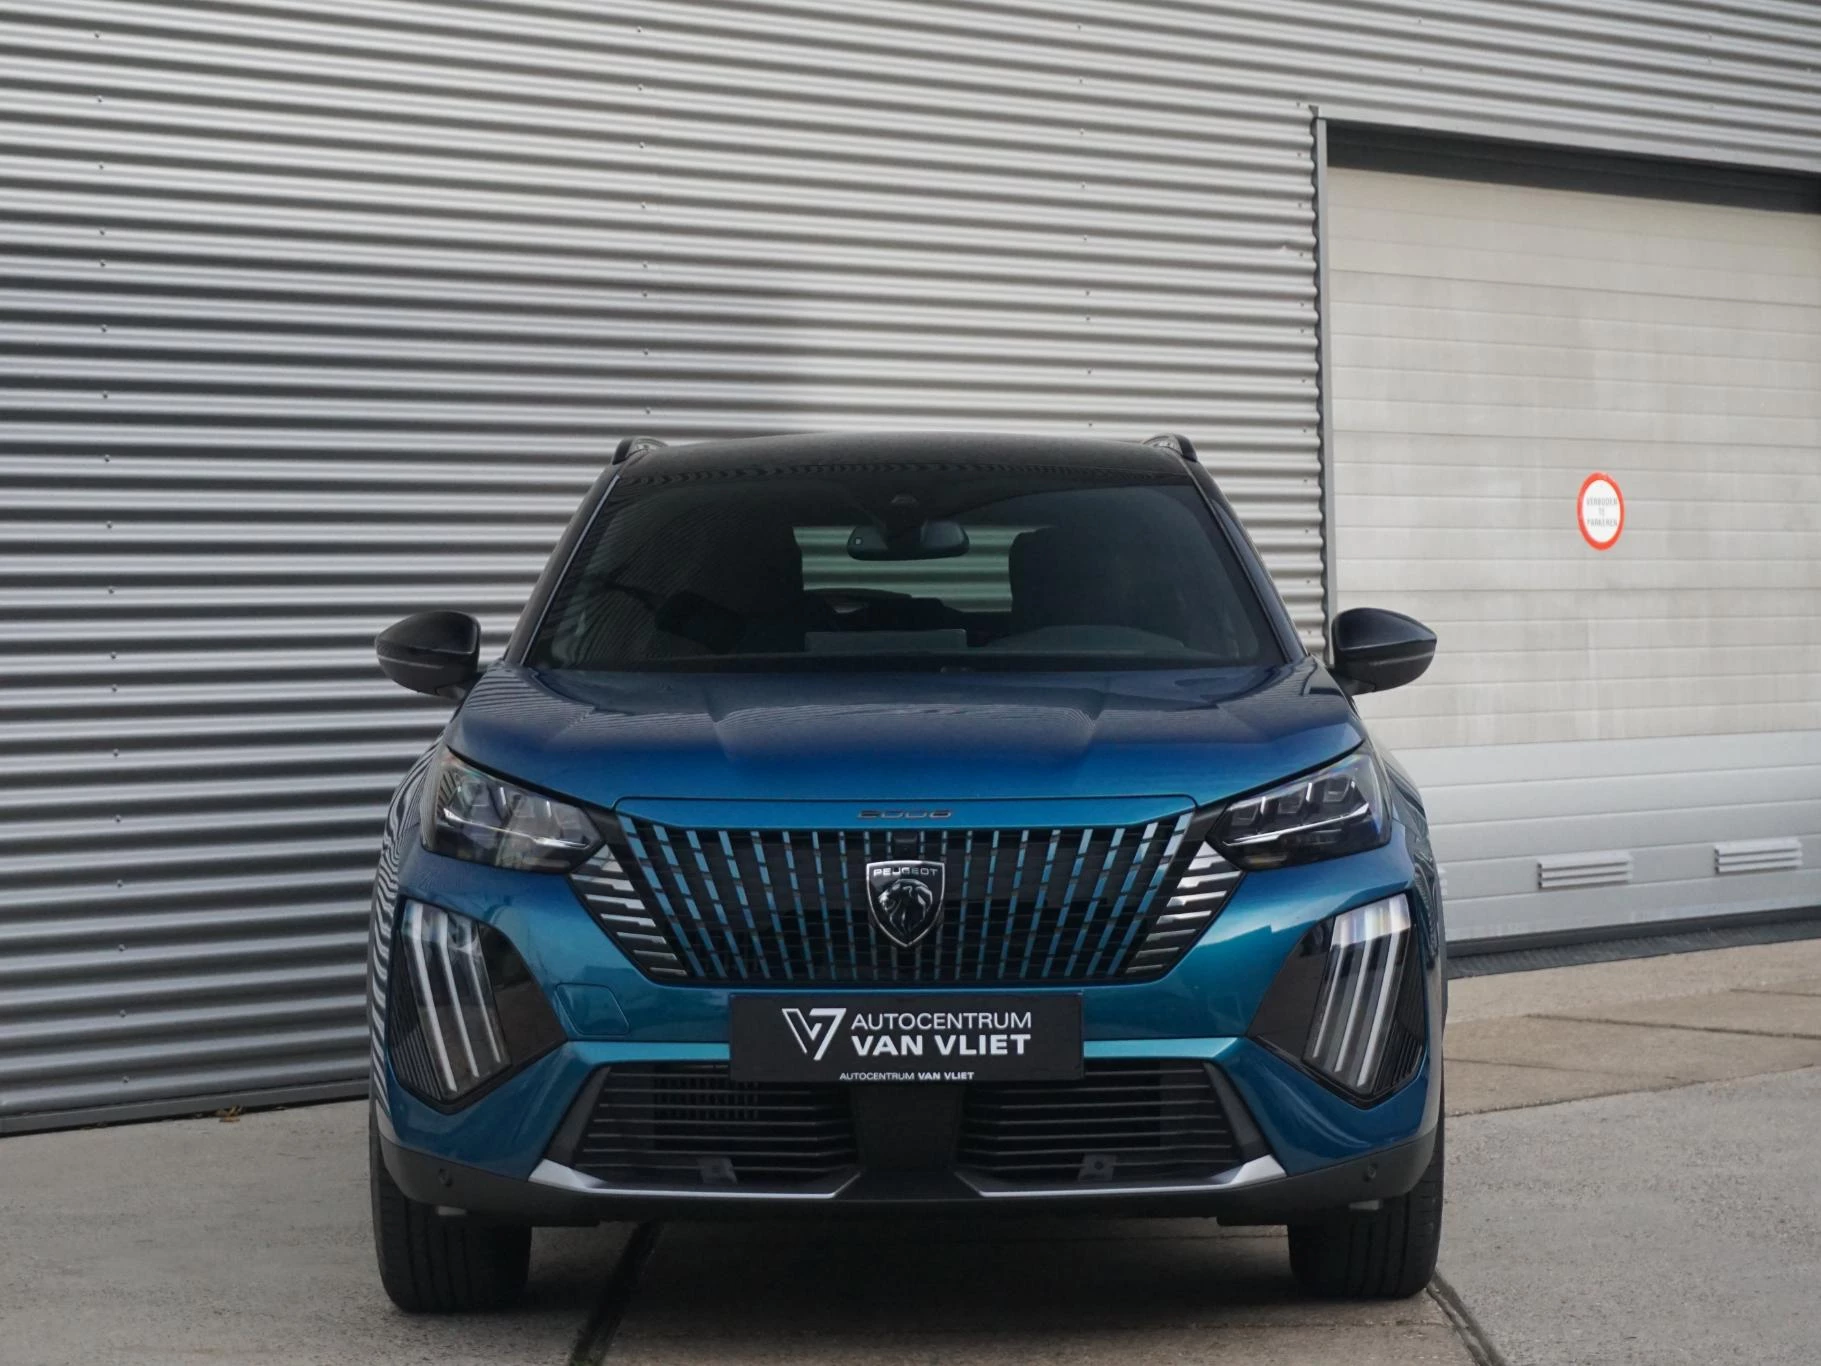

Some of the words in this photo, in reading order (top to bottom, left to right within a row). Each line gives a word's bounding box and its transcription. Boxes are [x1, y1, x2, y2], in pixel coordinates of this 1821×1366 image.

[873, 867, 939, 877] PEUGEOT
[850, 1011, 1032, 1030] AUTOCENTRUM
[850, 1034, 923, 1056] VAN
[934, 1034, 1032, 1056] VLIET
[839, 1071, 915, 1081] AUTOCENTRUM
[918, 1071, 941, 1081] VAN
[944, 1071, 975, 1081] VLIET
